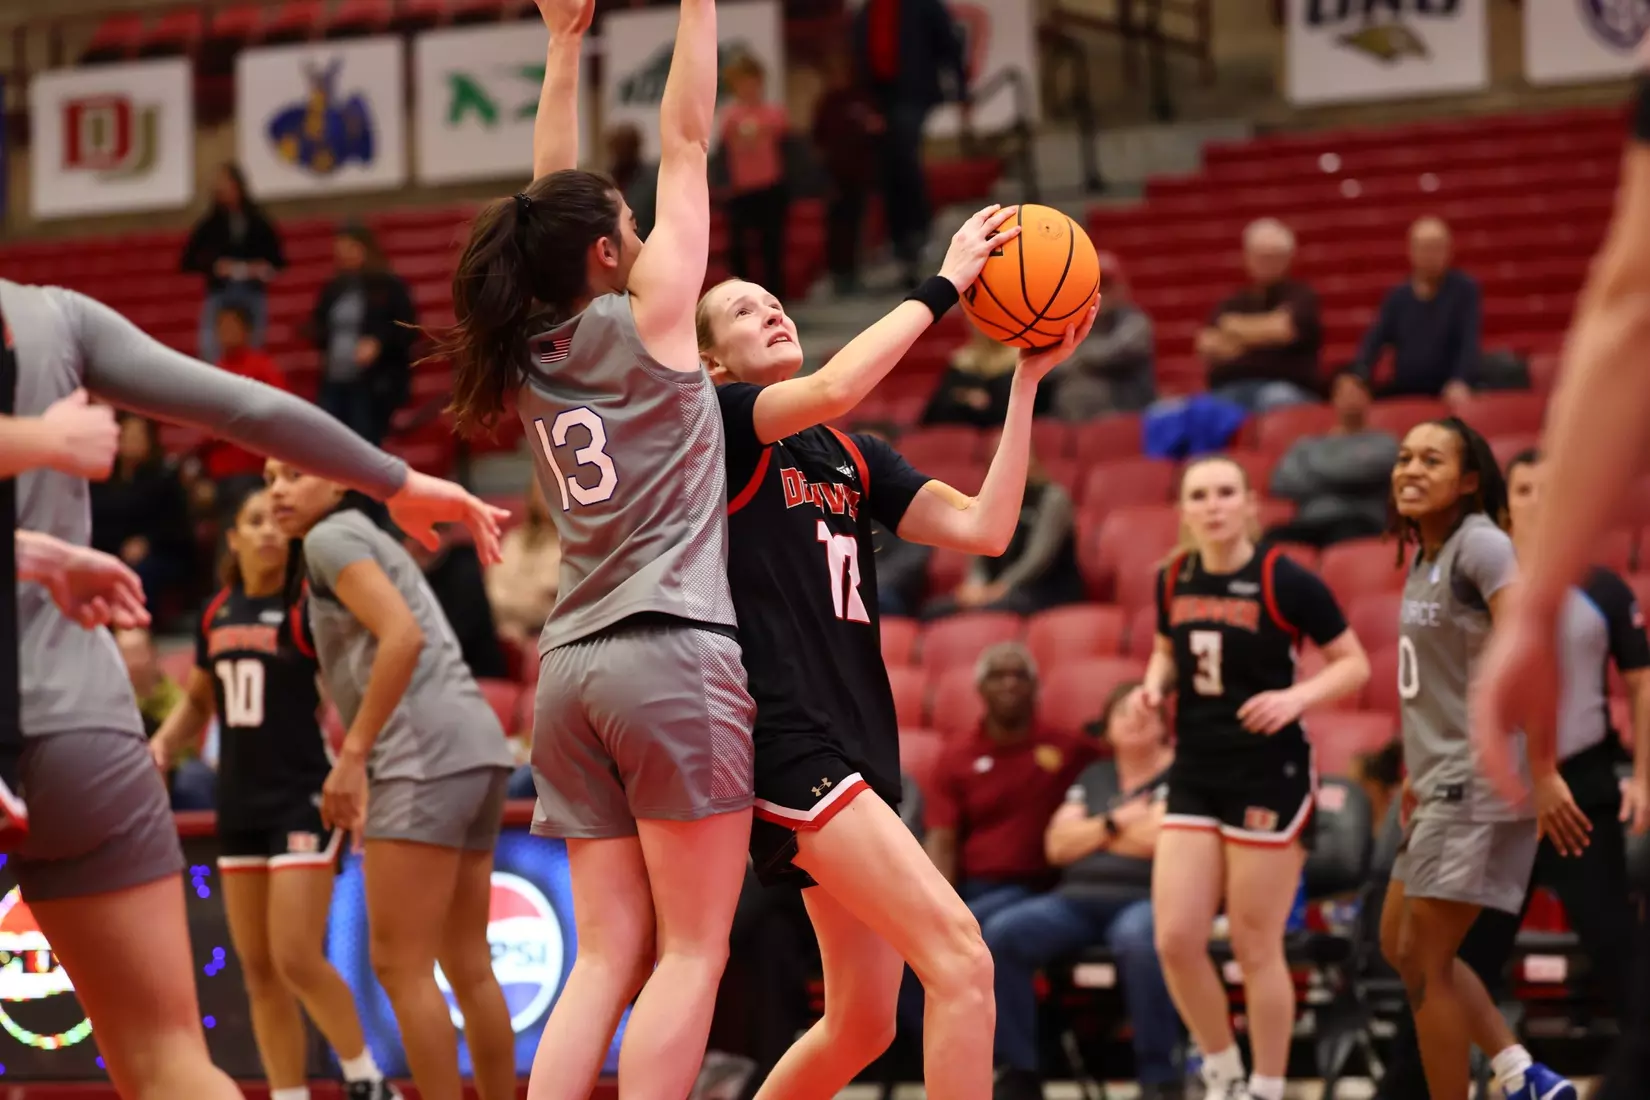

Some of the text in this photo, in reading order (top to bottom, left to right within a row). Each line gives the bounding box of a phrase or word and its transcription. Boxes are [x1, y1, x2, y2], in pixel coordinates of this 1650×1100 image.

[534, 405, 618, 511] 13
[215, 659, 265, 727] 10
[1190, 630, 1223, 695] 3
[490, 942, 546, 967] PSI
